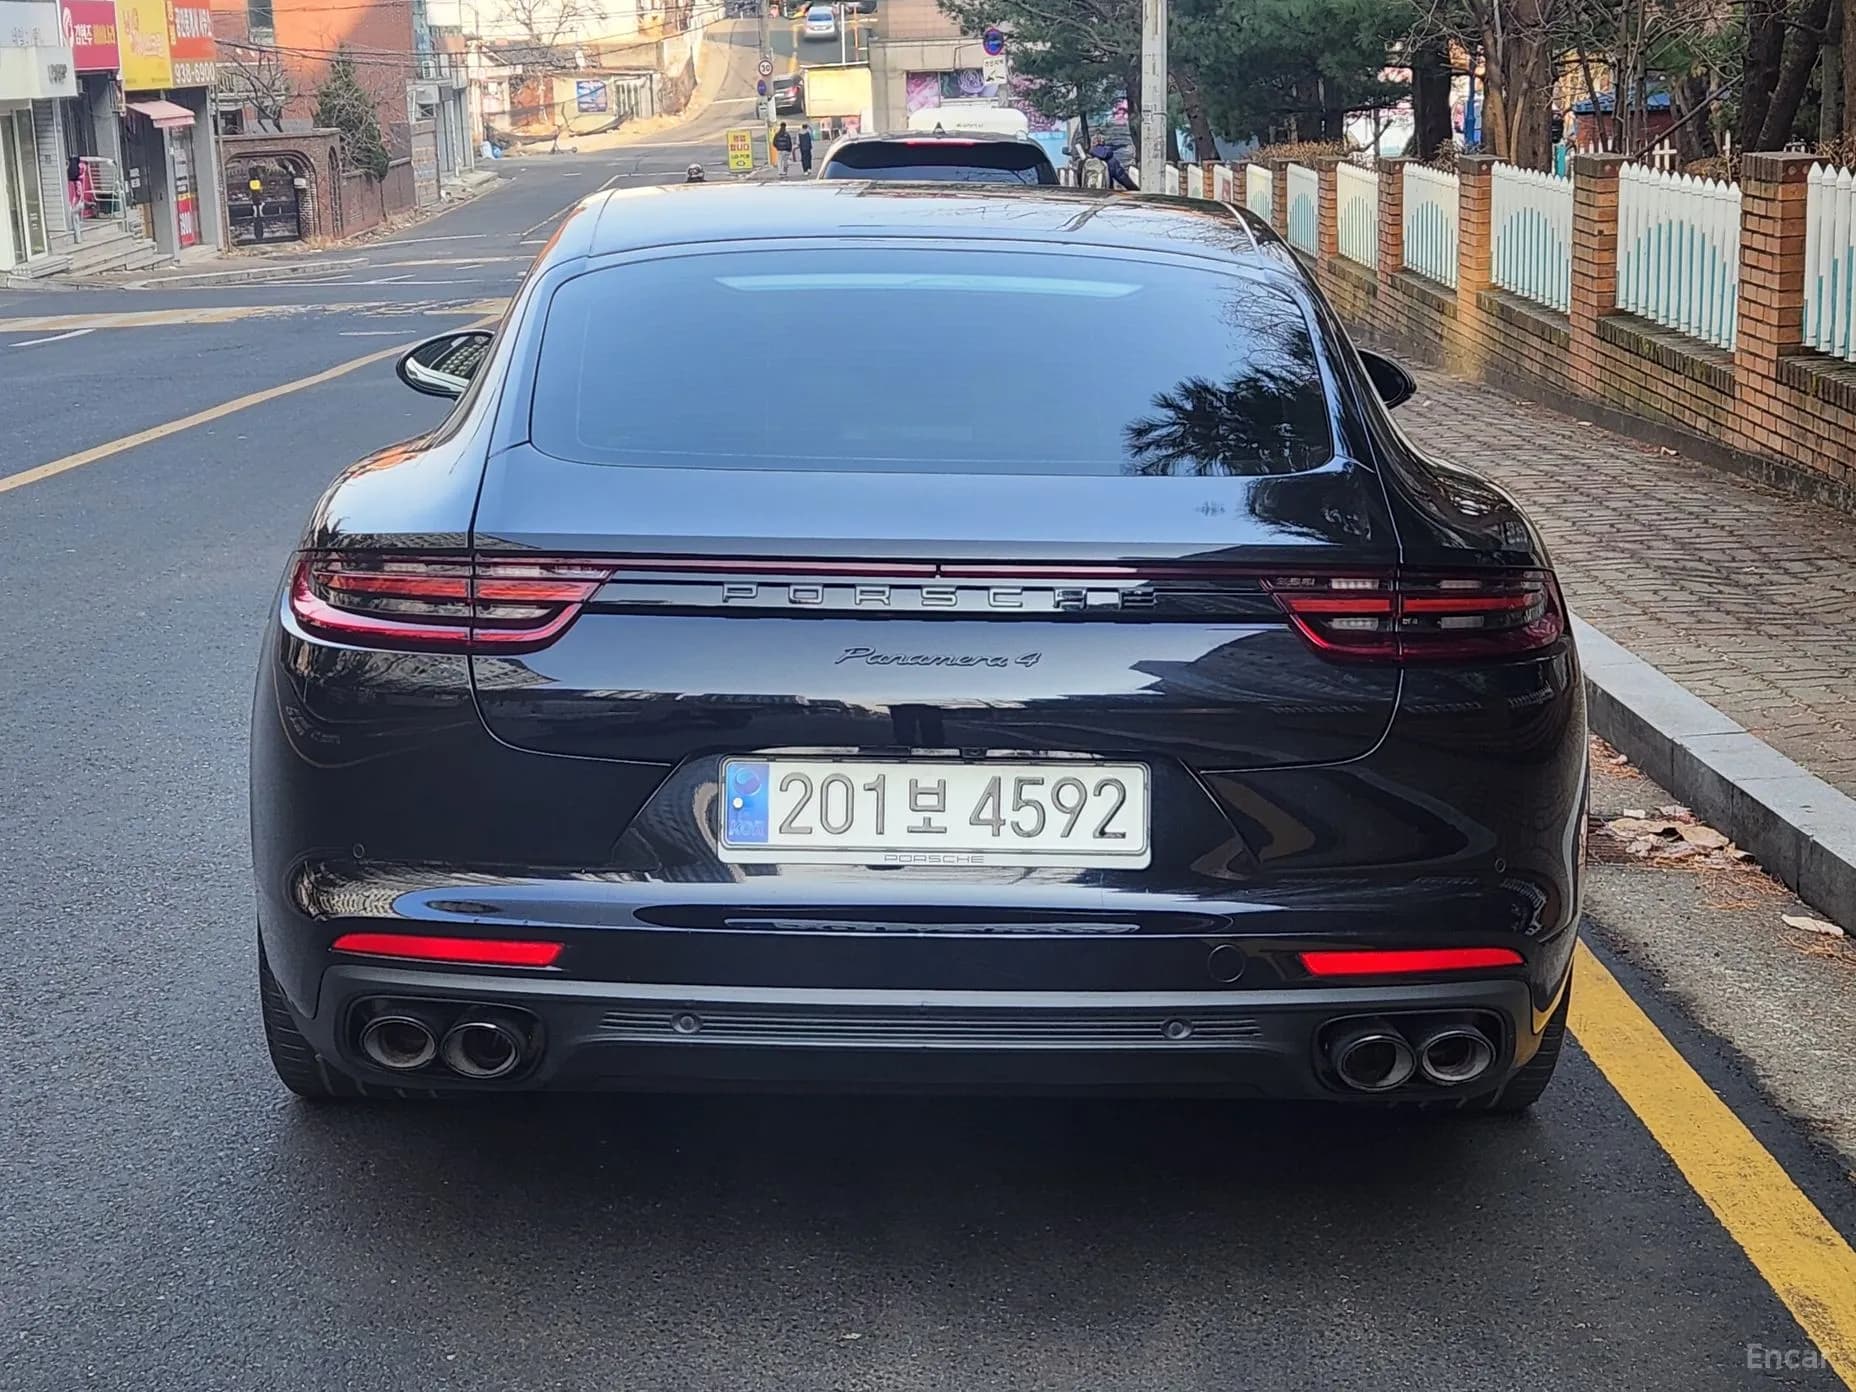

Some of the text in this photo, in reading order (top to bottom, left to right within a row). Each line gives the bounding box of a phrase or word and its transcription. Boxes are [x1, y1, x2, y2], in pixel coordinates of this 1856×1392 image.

[722, 583, 1156, 609] PORSCHE
[835, 647, 1042, 668] Panamera 4
[779, 772, 1127, 840] 201 보 4592
[884, 854, 984, 863] PORSCHE
